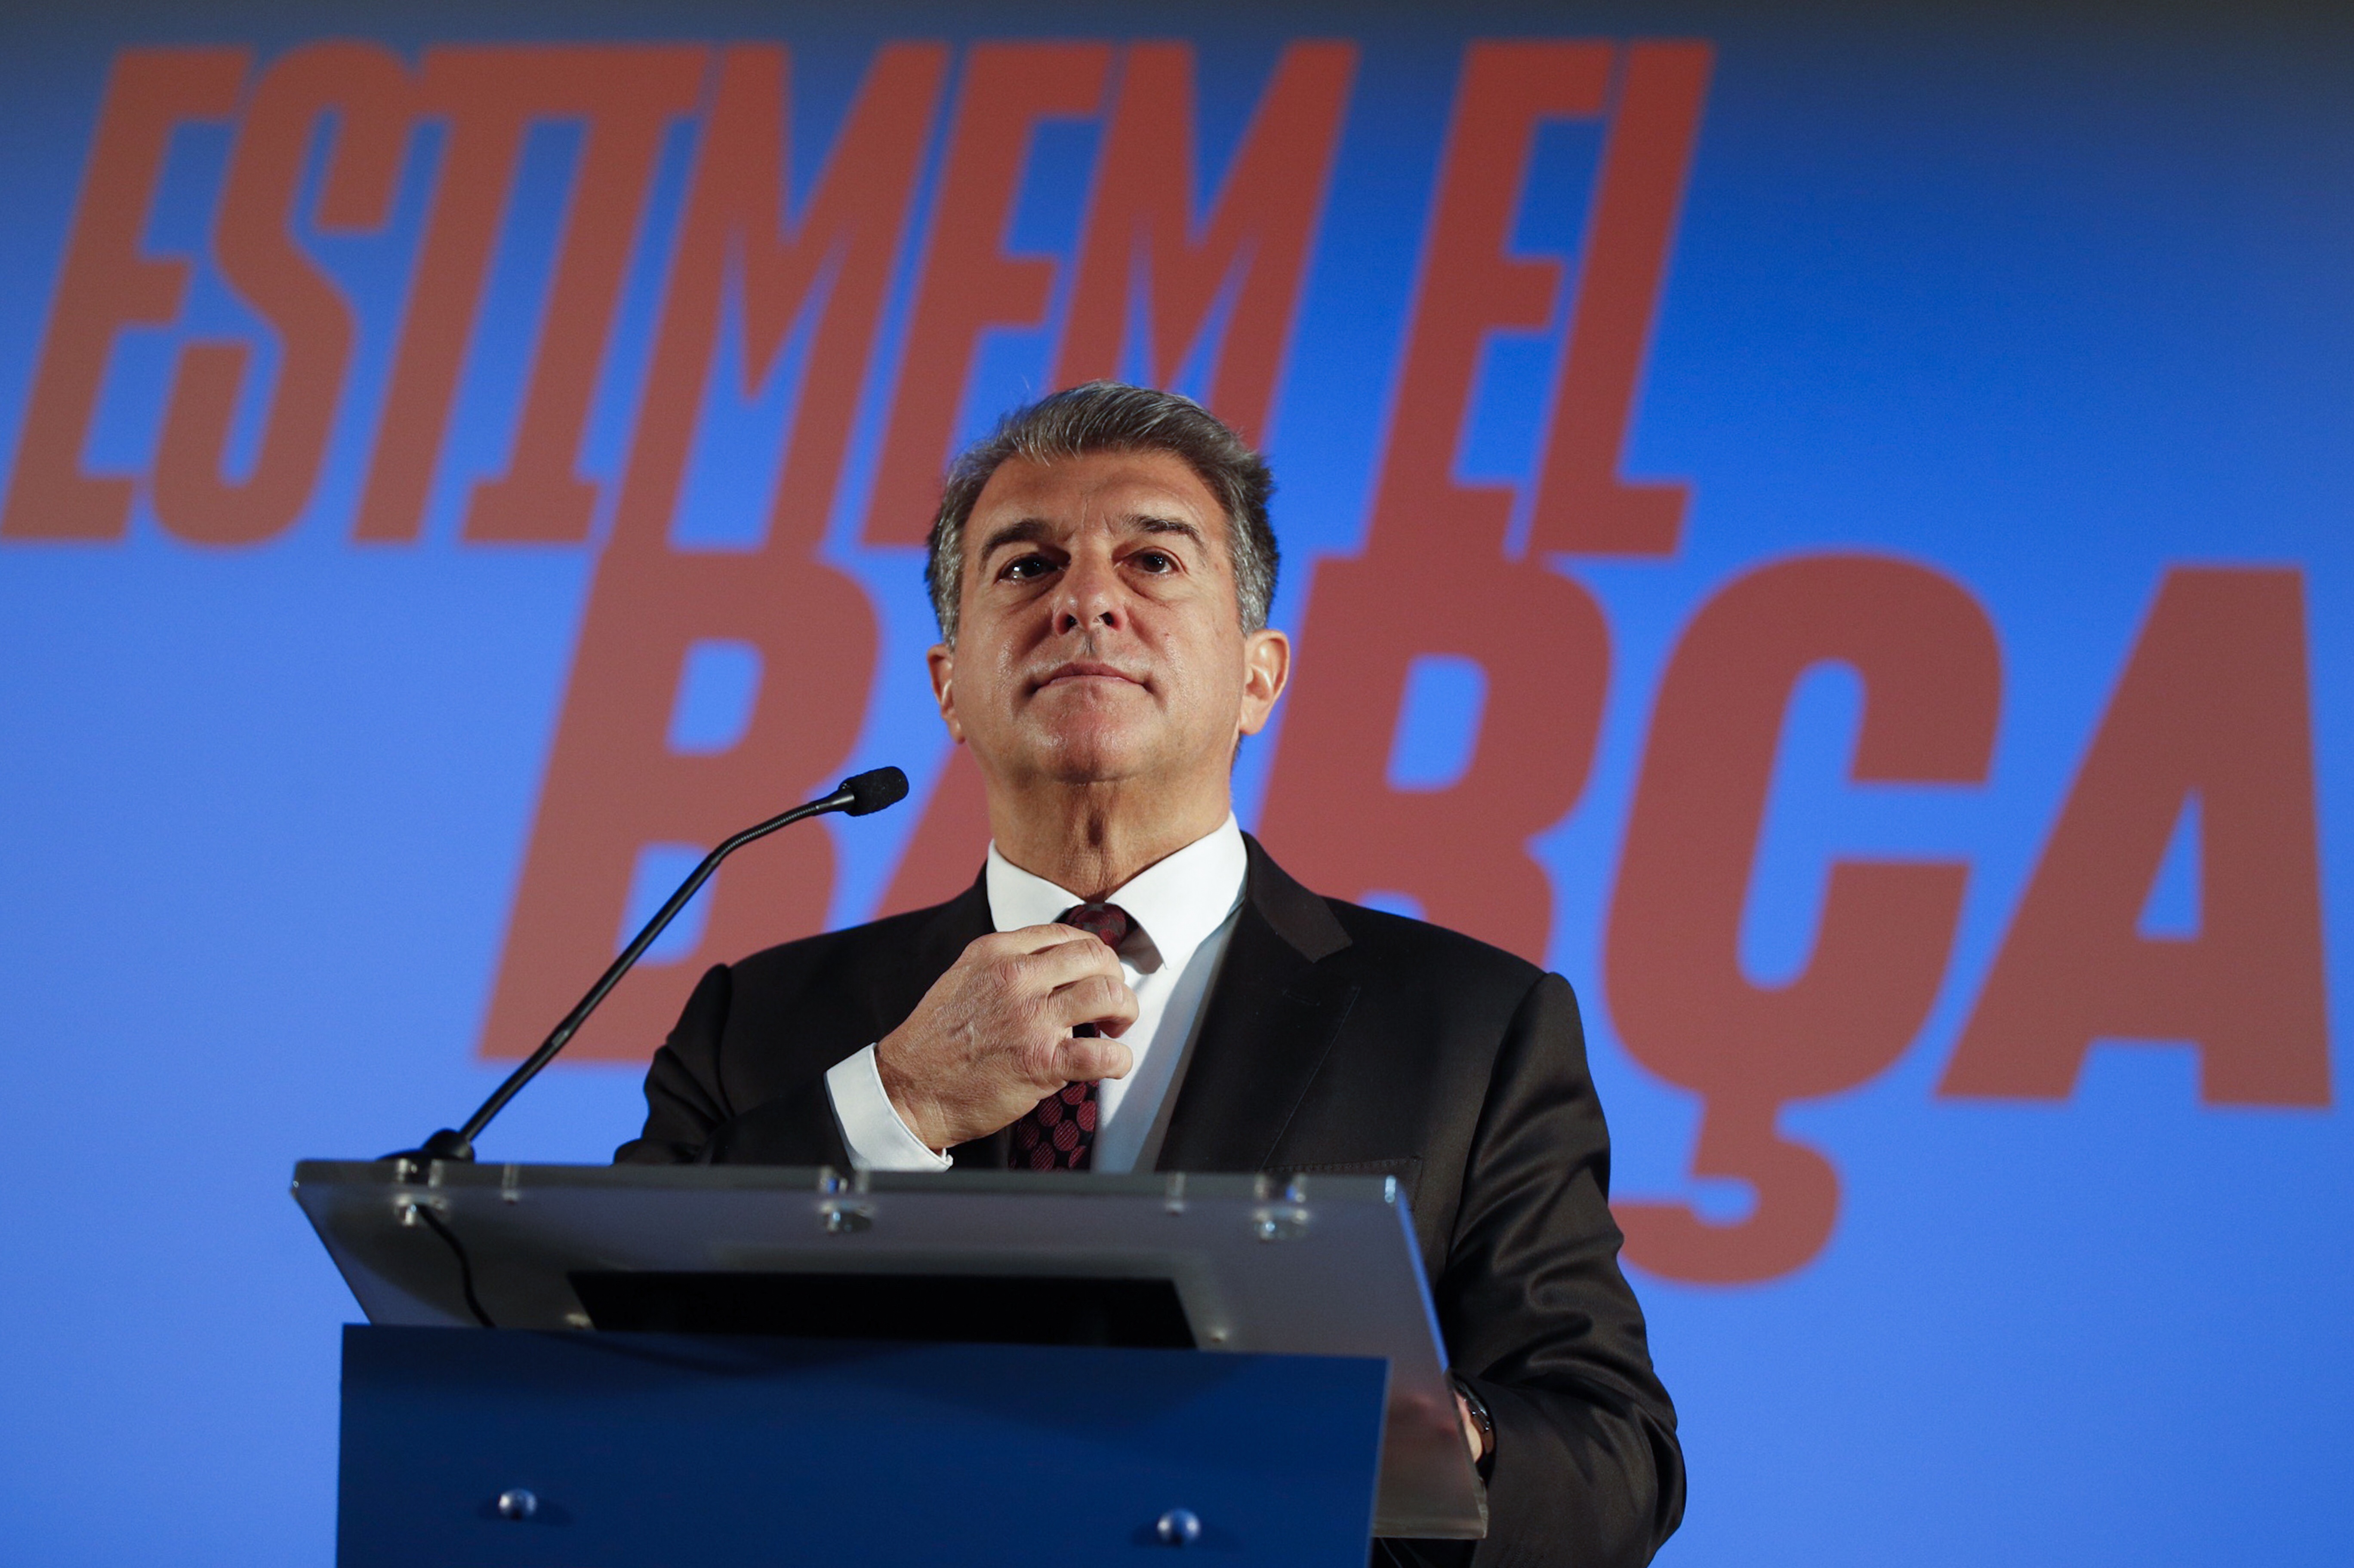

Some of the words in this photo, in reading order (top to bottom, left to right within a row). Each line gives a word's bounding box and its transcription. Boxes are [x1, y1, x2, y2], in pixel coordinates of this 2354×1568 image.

[1, 37, 1359, 548] ESTIMEM
[1362, 38, 1713, 556] EL
[478, 550, 2334, 1285] BRÇA
